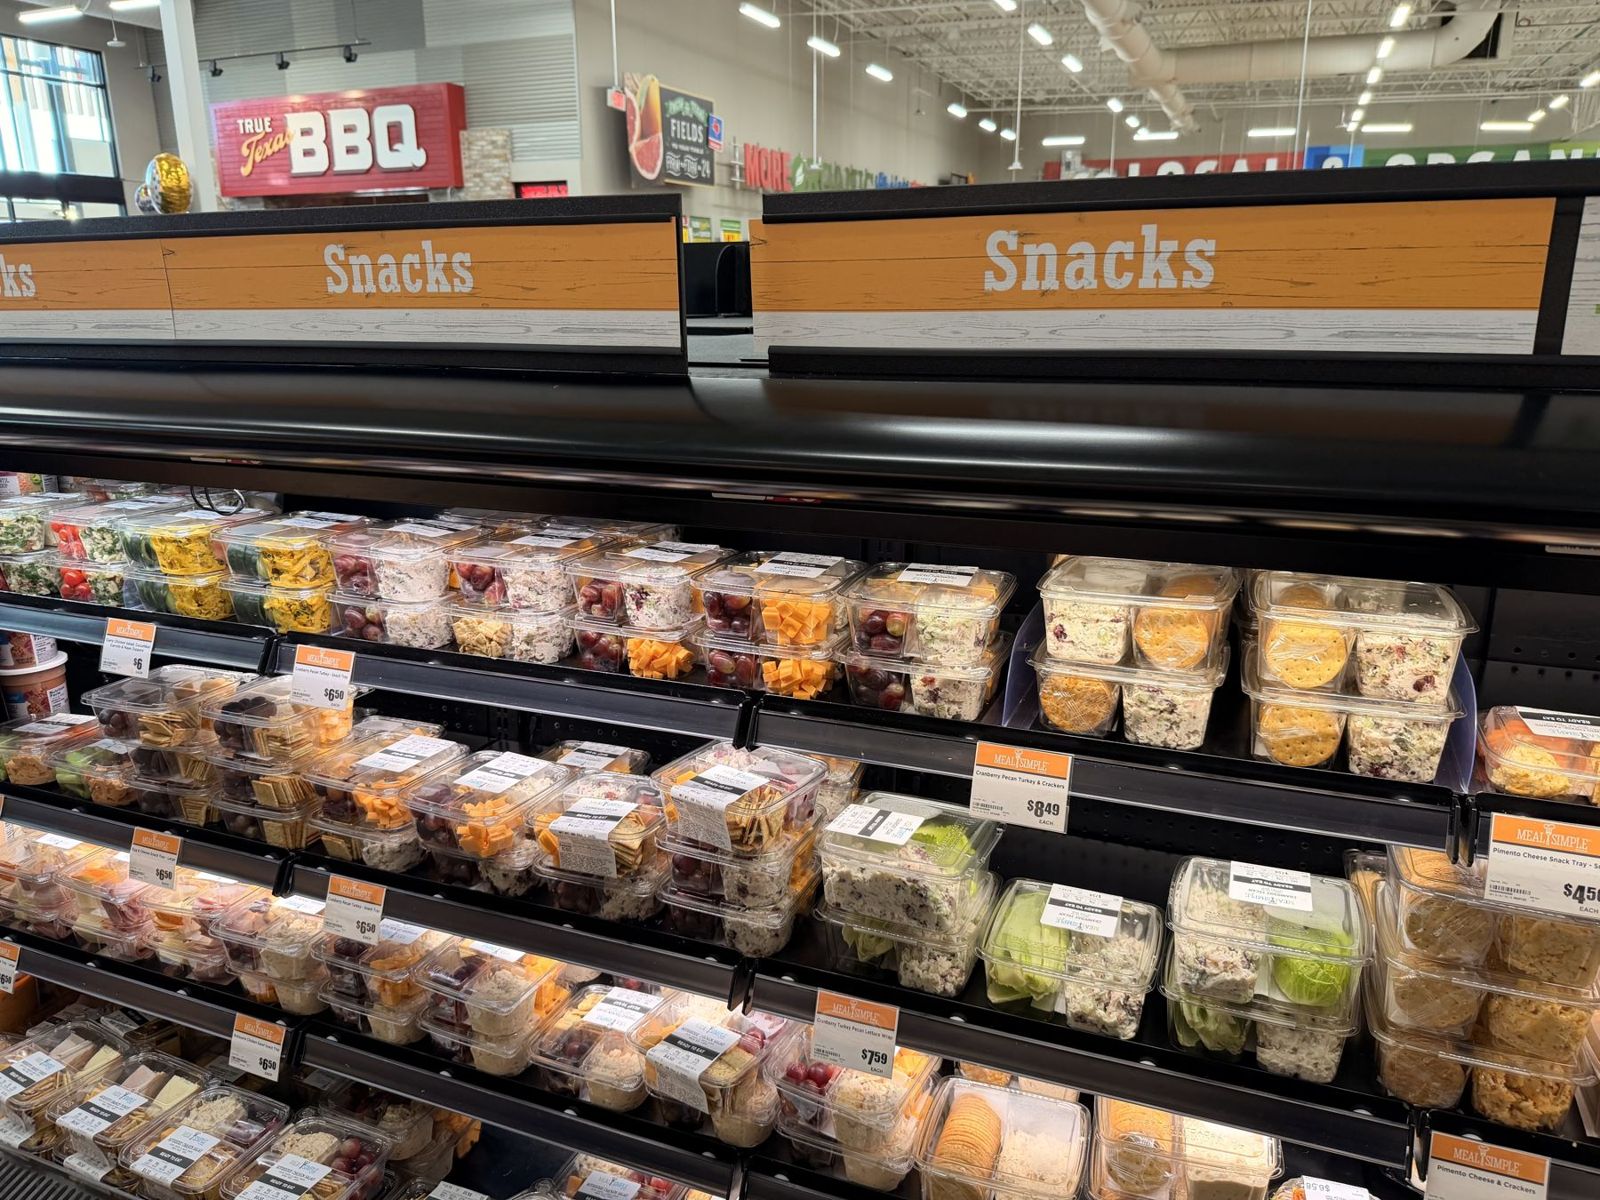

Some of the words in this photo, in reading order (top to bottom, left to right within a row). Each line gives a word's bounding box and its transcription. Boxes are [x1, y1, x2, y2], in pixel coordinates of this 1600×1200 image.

[236, 116, 273, 135] TRUE
[670, 118, 704, 143] FIELDS
[284, 104, 428, 177] BBQ
[240, 128, 296, 177] Texas
[744, 143, 792, 192] MORE
[322, 240, 474, 295] Snacks
[984, 224, 1217, 293] Snacks
[133, 657, 143, 670] $6
[993, 754, 1016, 766] MEAL
[1019, 758, 1048, 772] SIMPLE
[975, 770, 1001, 779] Cranberry
[1042, 781, 1065, 789] Crackers
[1516, 828, 1544, 842] MEAL
[1551, 833, 1589, 850] SIMPLE
[1492, 847, 1521, 857] Pimento
[1522, 851, 1548, 862] Cheese
[1549, 856, 1570, 865] Snack
[1572, 859, 1587, 868] Tray
[1273, 881, 1294, 889] READY
[1579, 905, 1599, 914] EACH
[816, 1017, 837, 1028] Cranberry
[837, 1022, 851, 1031] Turkey
[676, 1039, 692, 1049] READY
[697, 1046, 706, 1054] EAT
[1453, 1147, 1480, 1164] MEAL
[1485, 1154, 1520, 1172] SIMPLE
[1437, 1164, 1467, 1177] Pimento
[1468, 1172, 1495, 1185] Cheese
[1503, 1181, 1536, 1195] Crackers
